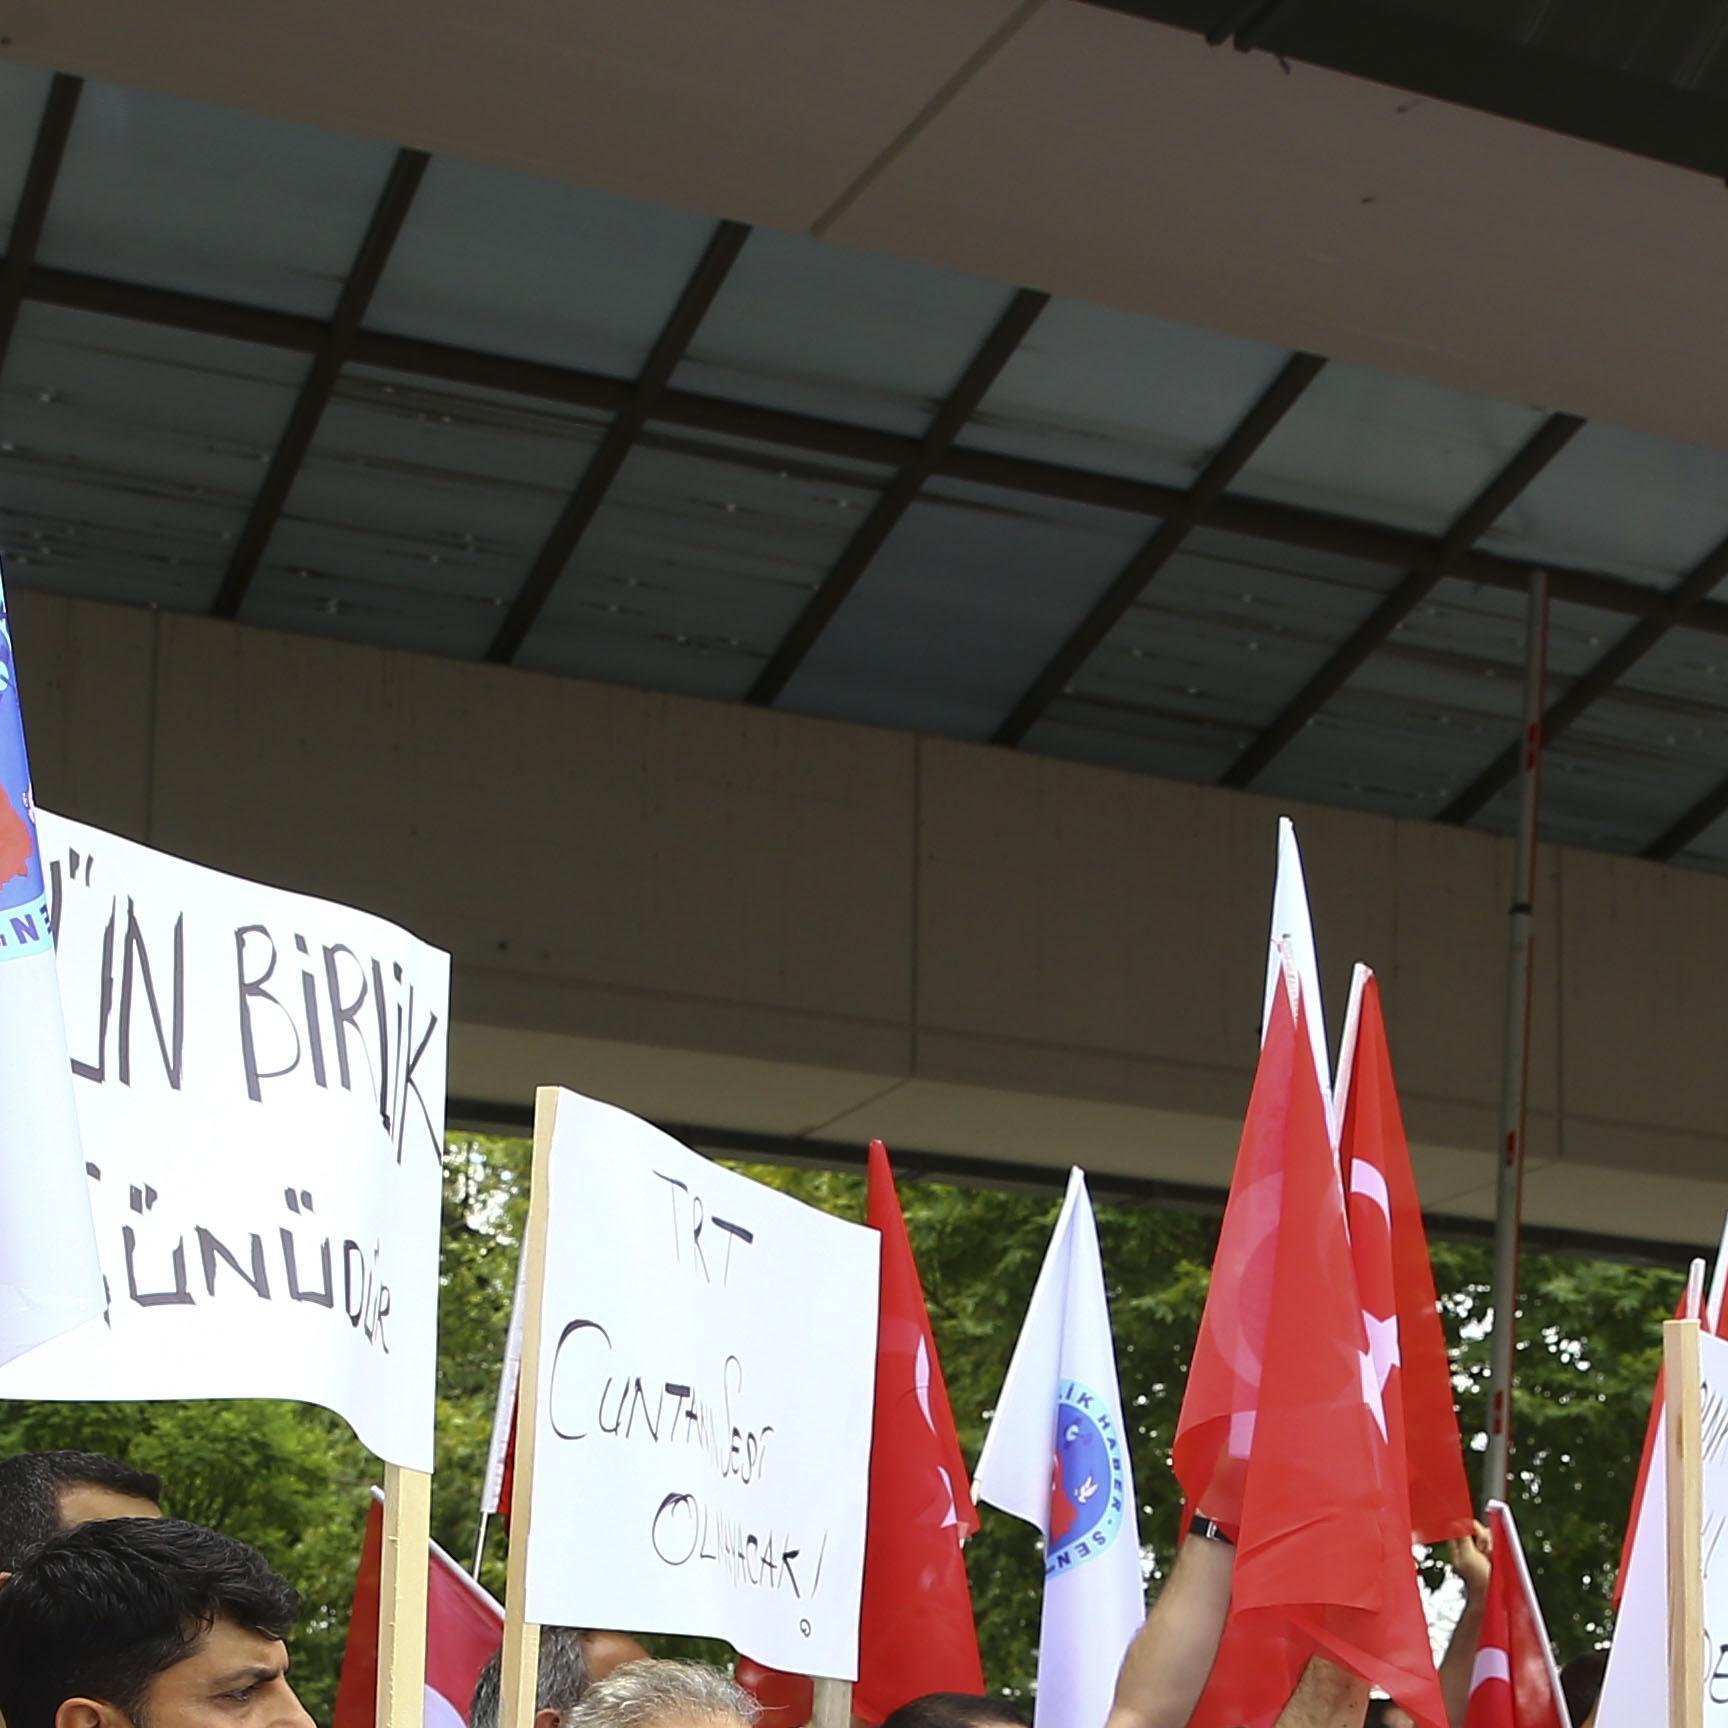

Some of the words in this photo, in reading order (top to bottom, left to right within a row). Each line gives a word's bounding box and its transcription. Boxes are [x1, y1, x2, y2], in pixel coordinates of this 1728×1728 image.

[235, 924, 444, 1166] BİRLİK
[86, 1161, 390, 1354] ÜNÜDÜR
[653, 1169, 755, 1287] TRT
